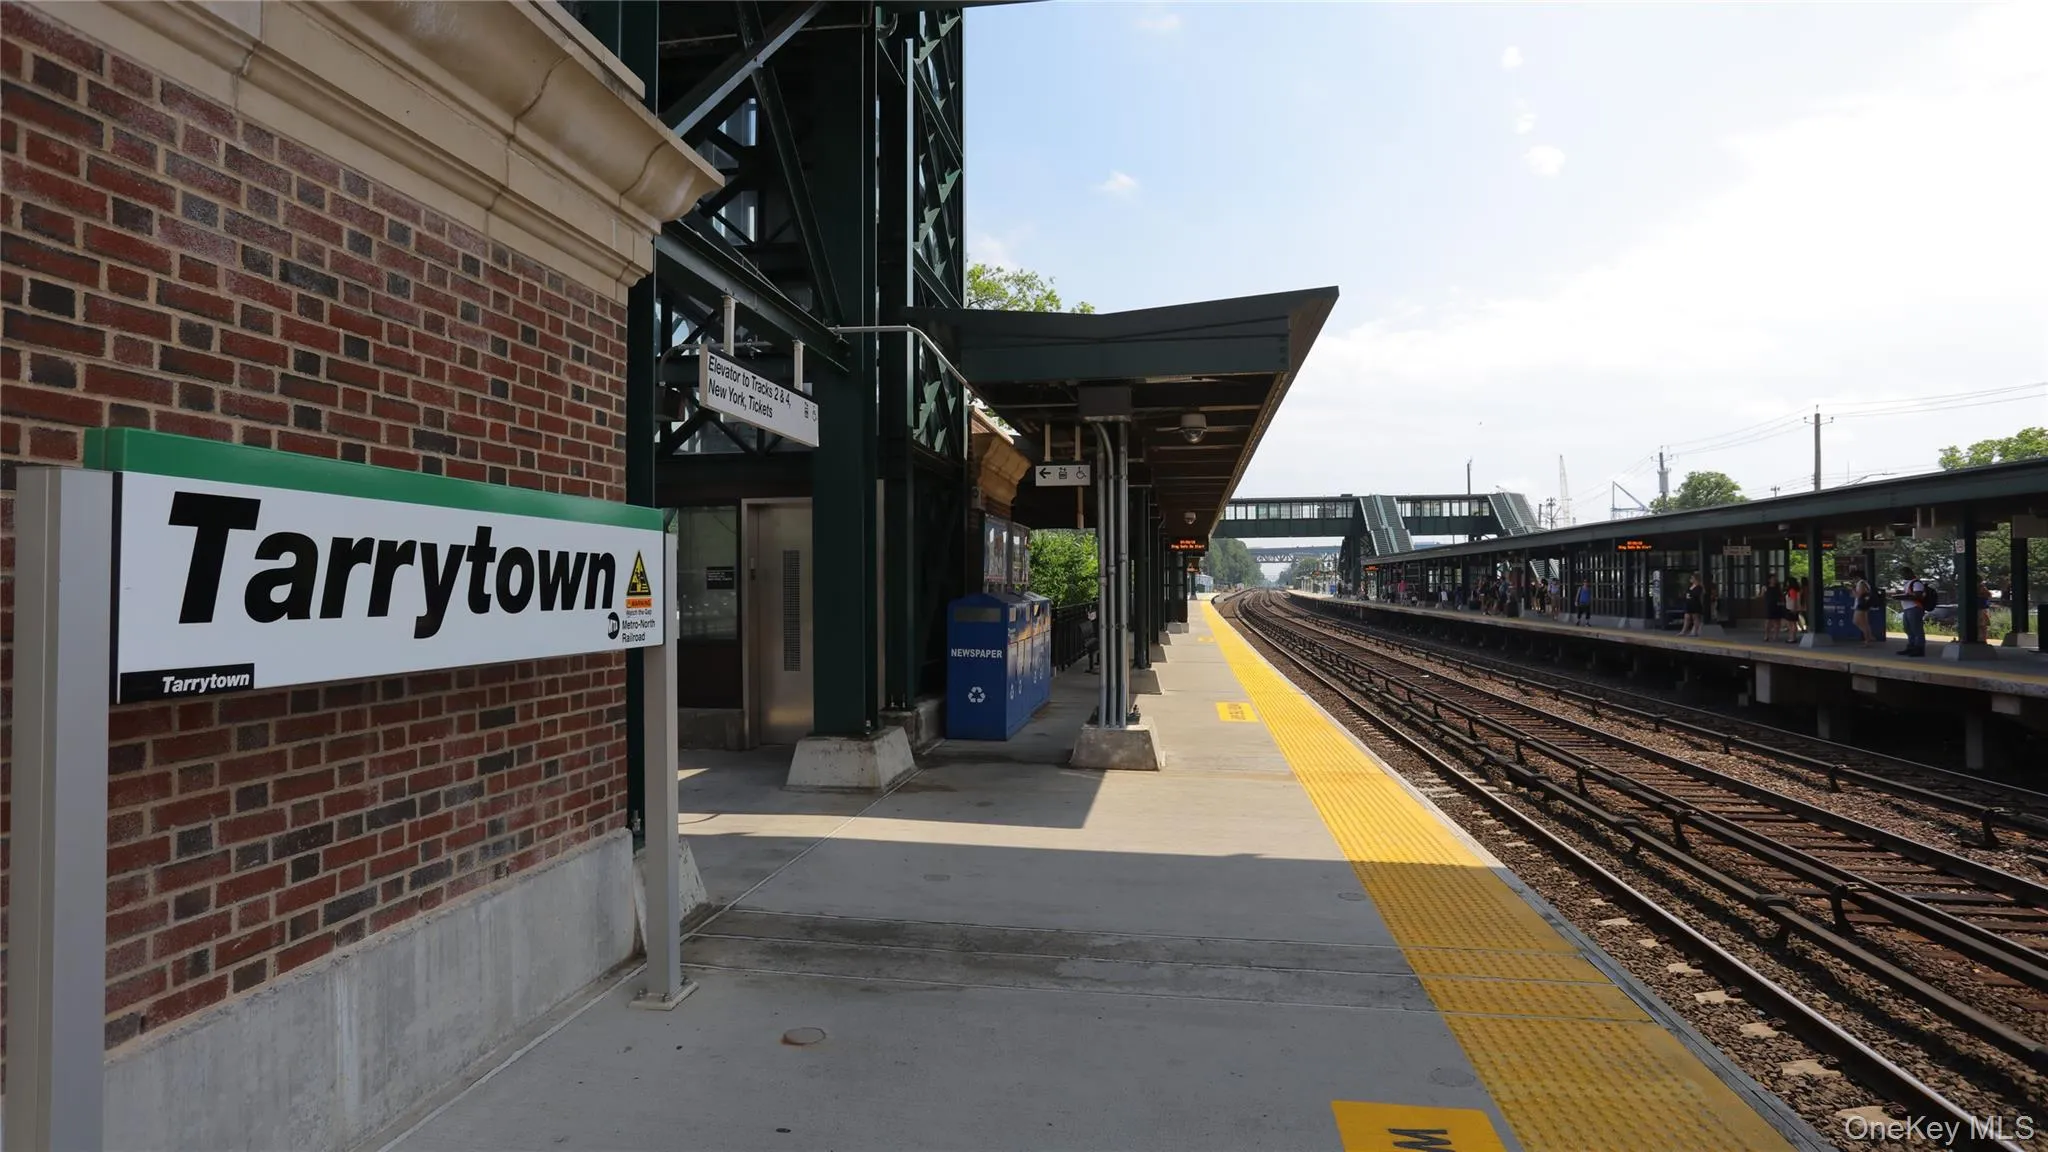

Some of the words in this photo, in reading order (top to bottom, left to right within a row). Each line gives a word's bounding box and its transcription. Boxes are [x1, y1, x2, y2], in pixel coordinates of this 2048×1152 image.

[709, 356, 741, 381] Elevator
[743, 372, 750, 387] to
[752, 376, 772, 398] Tracks
[774, 387, 778, 400] 2
[780, 390, 784, 403] &
[708, 378, 726, 400] New
[729, 386, 747, 410] York,
[749, 395, 773, 418] Tickets
[168, 491, 616, 639] Tarrytown
[622, 619, 655, 630] Metro-North
[622, 633, 645, 643] Railroad
[950, 648, 1003, 659] NEWSPAPER
[162, 672, 250, 694] Tarrytown
